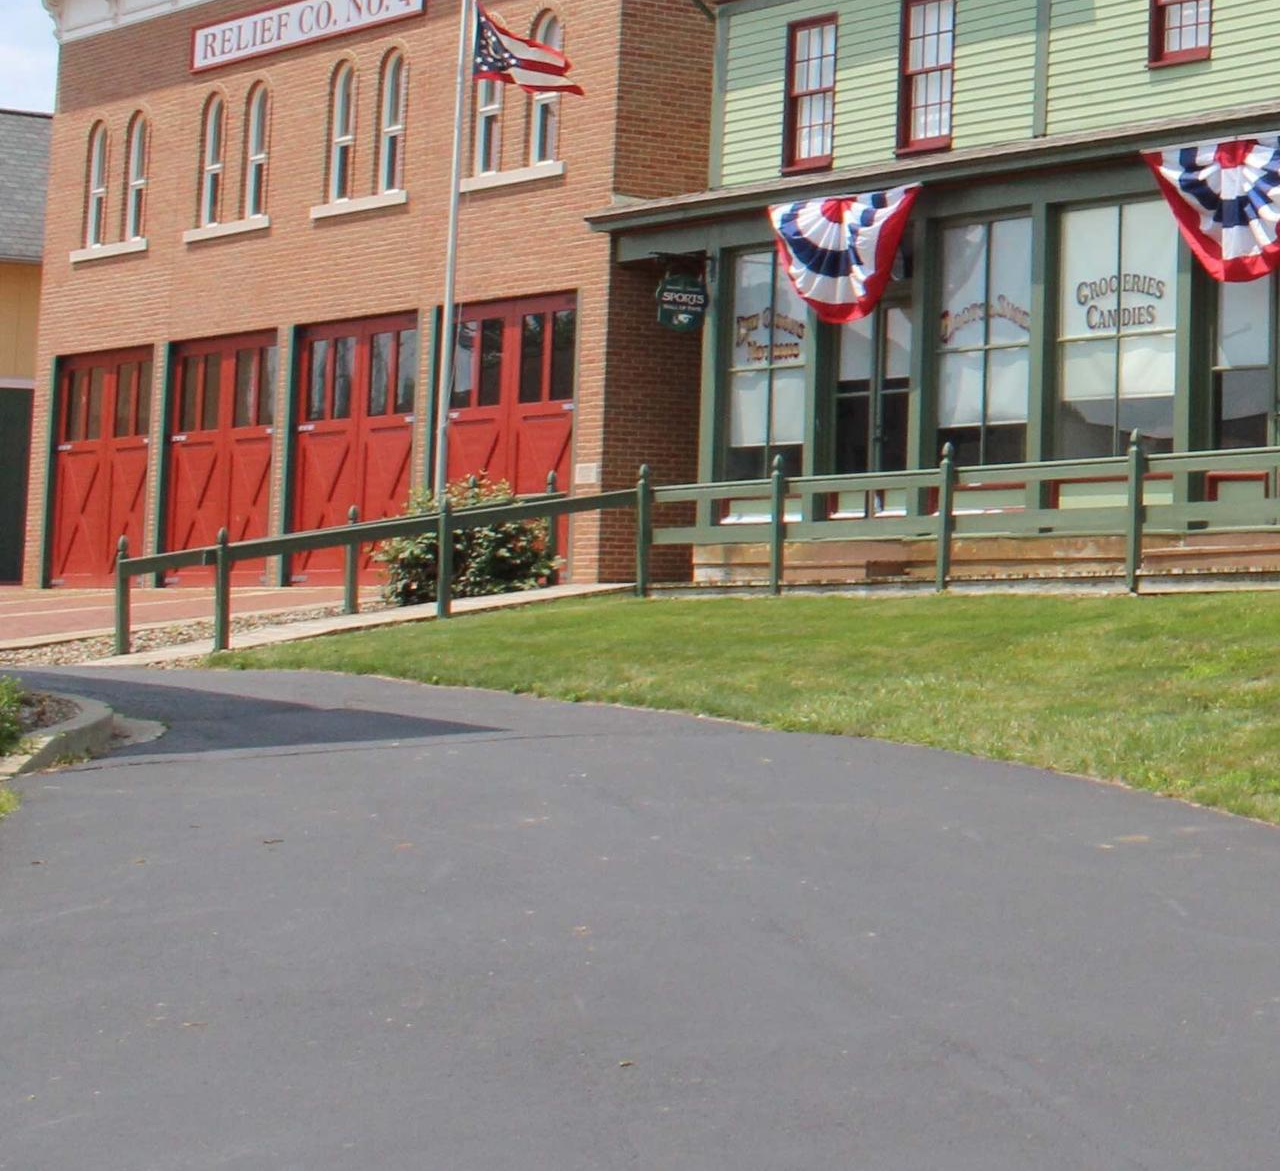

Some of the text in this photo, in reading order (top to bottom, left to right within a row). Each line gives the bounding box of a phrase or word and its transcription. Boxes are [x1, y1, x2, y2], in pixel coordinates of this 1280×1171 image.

[202, 11, 290, 60] RELIEF
[298, 0, 338, 35] CO.
[661, 291, 705, 305] SPORTS
[1076, 273, 1165, 306] GROCERIES
[1086, 304, 1156, 330] CANDIES
